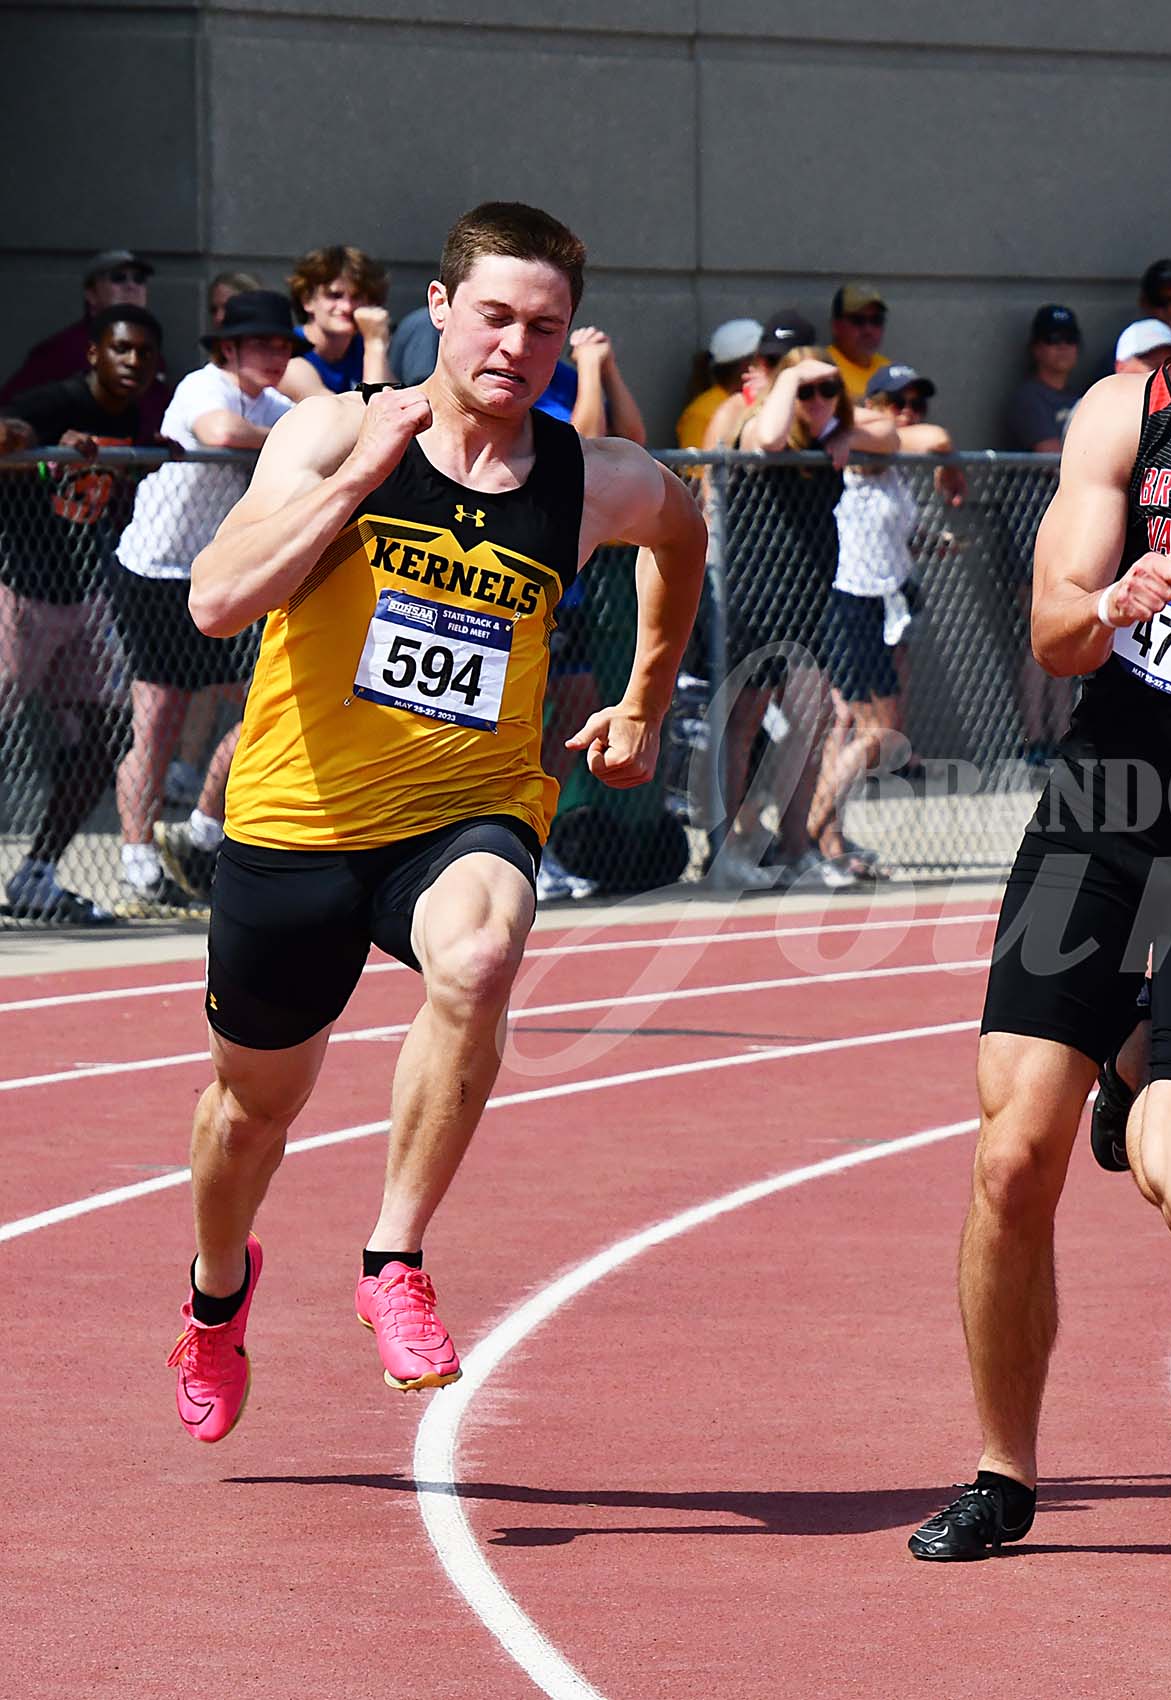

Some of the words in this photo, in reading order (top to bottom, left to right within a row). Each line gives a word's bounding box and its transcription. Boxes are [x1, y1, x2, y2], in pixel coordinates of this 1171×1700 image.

[370, 536, 541, 615] KERNELS
[443, 609, 466, 623] STATE
[466, 614, 493, 629] TRACK
[493, 622, 501, 631] &
[447, 622, 469, 635] FIELD
[469, 628, 491, 640] MEET
[382, 635, 485, 706] 594
[1132, 667, 1145, 678] MAY
[394, 700, 413, 709] MAY
[437, 711, 456, 721] 2023
